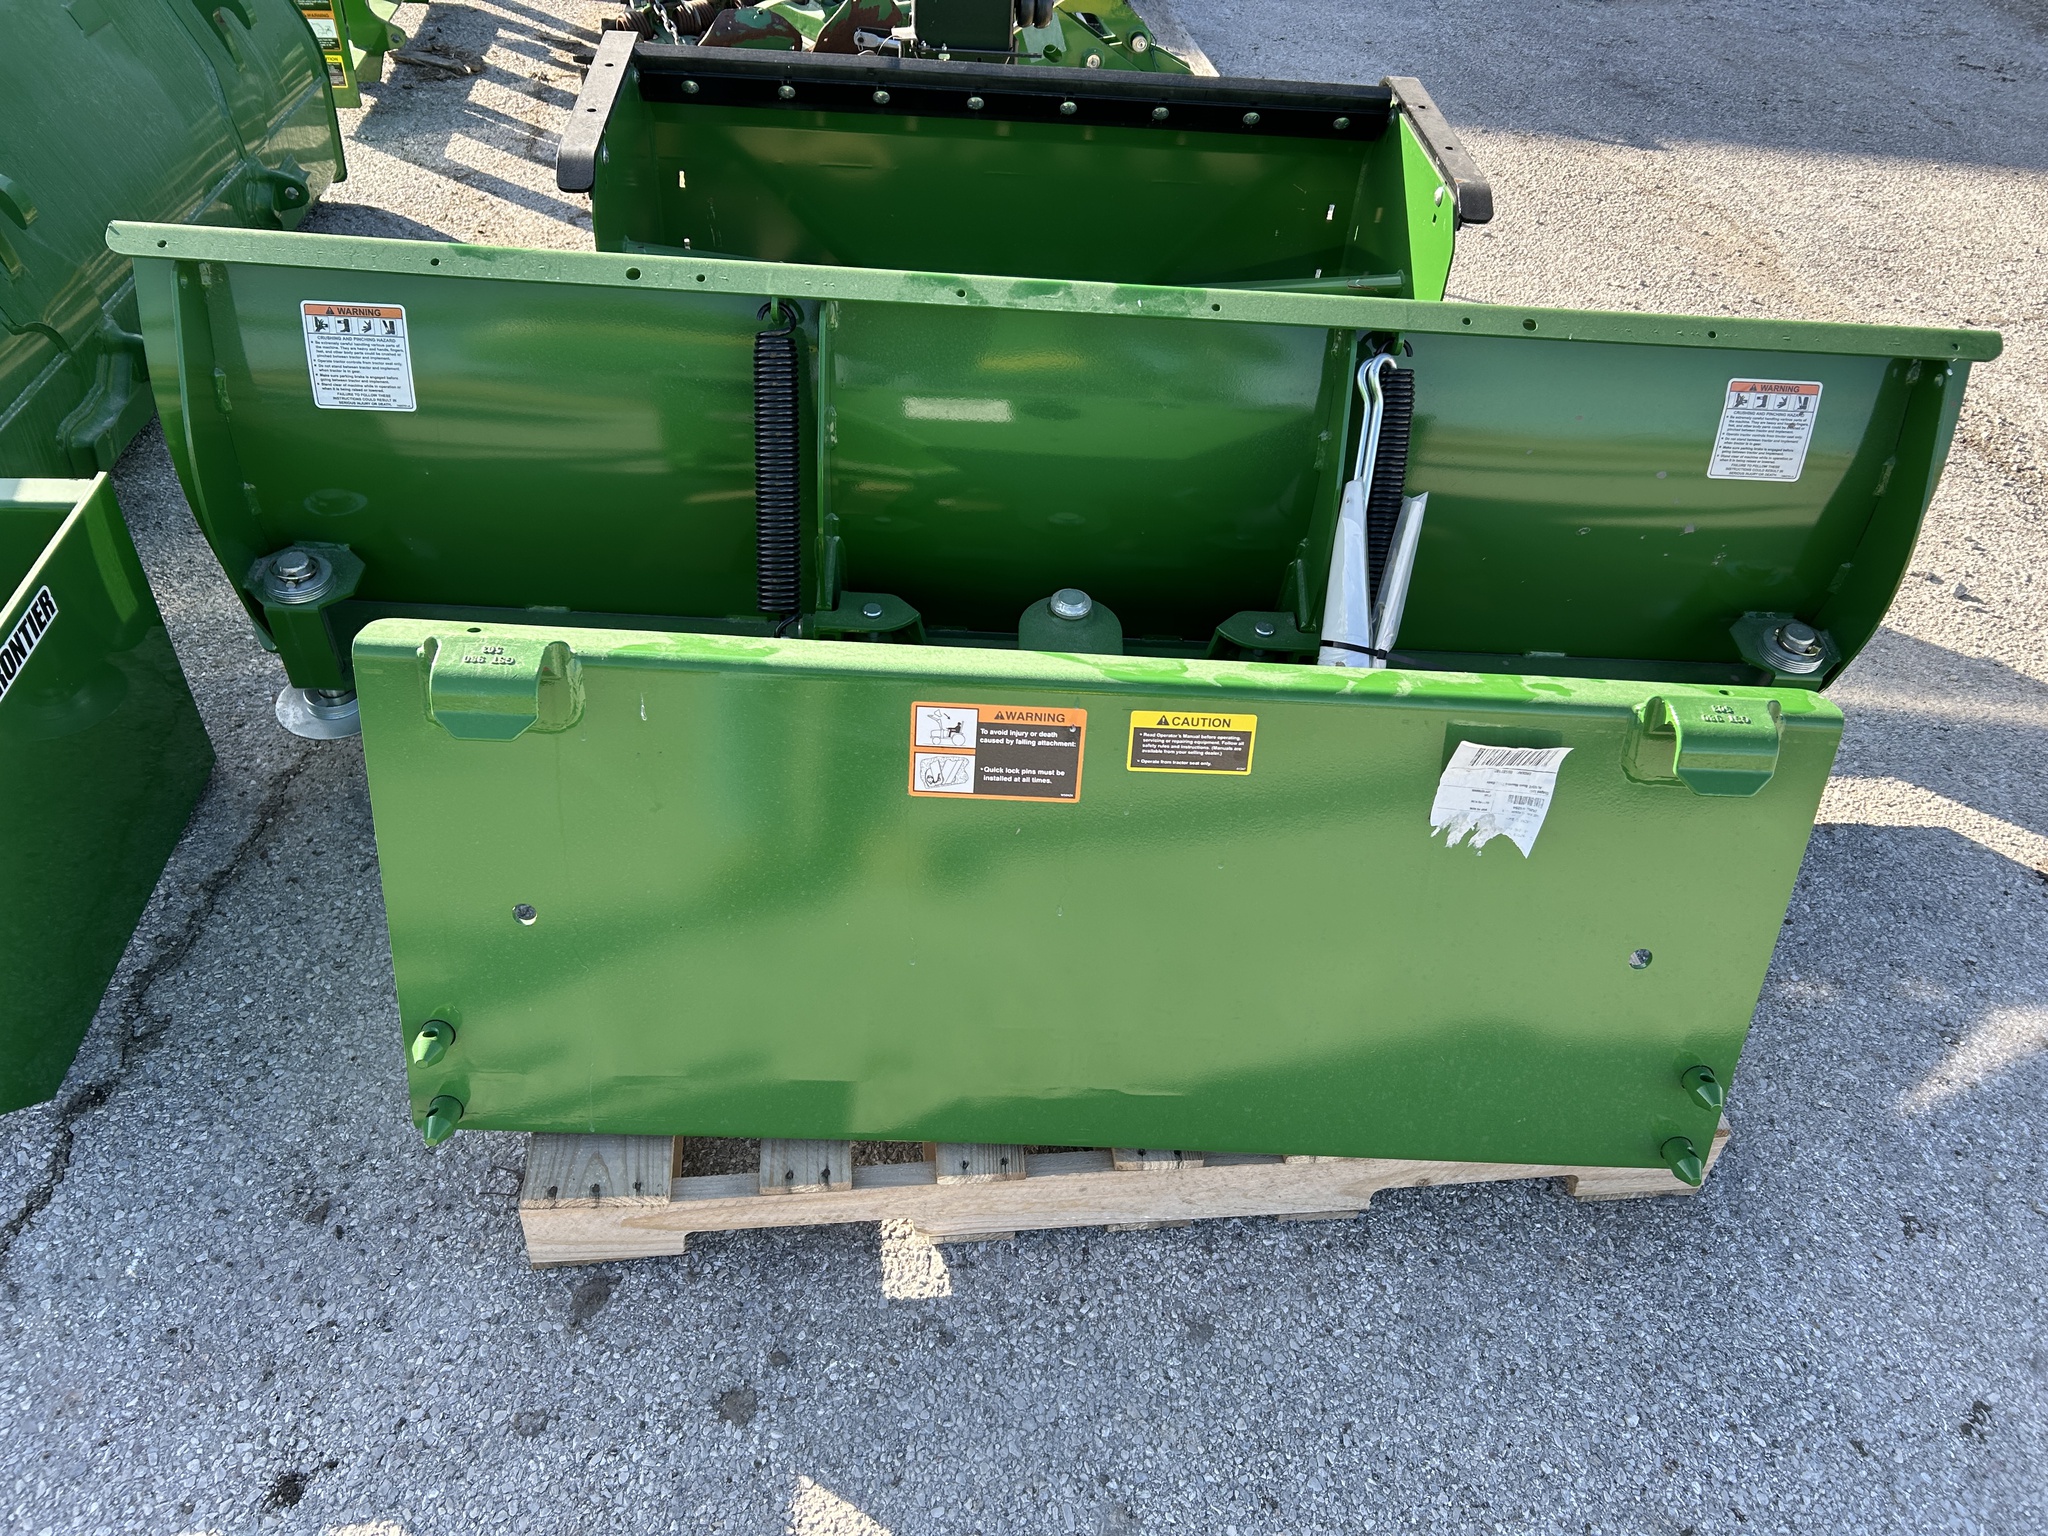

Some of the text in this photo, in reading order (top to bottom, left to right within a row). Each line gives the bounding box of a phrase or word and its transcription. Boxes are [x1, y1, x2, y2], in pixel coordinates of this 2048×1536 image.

[337, 307, 381, 317] WARNING
[1760, 384, 1800, 393] WARNING
[1005, 711, 1065, 723] WARNING
[1172, 716, 1232, 728] CAUTION
[980, 728, 989, 736] To
[1009, 729, 1029, 738] injury
[1030, 730, 1038, 738] or
[1005, 738, 1015, 746] by
[1015, 738, 1036, 747] falling
[1037, 740, 1077, 748] attachment:
[1021, 769, 1037, 777] pins
